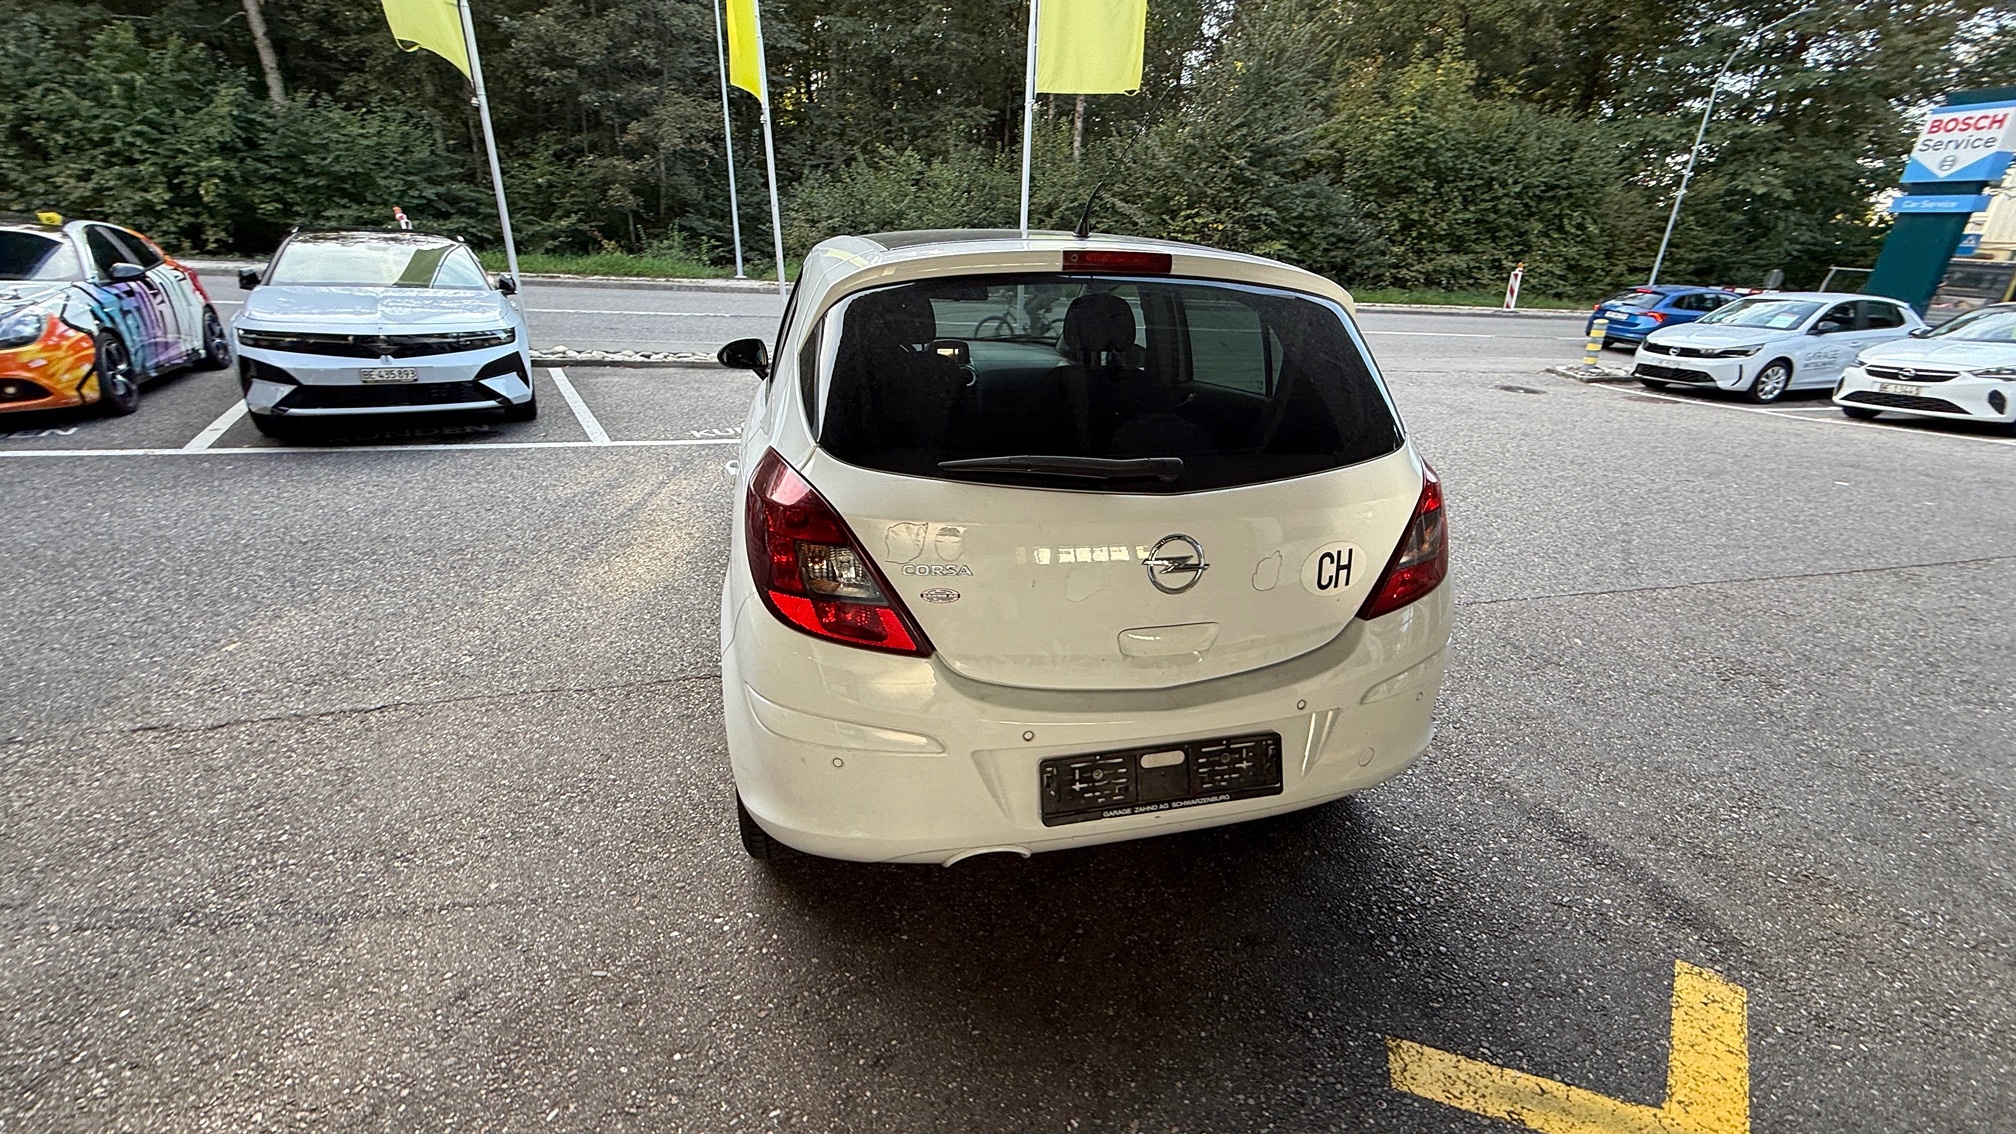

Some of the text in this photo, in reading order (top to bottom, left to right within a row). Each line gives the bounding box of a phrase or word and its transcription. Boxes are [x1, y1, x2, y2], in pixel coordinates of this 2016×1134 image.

[1927, 113, 2009, 134] BOSCH
[1917, 134, 1998, 152] Service
[902, 564, 974, 576] CORSA
[1317, 548, 1353, 590] CH
[1102, 794, 1230, 817] GARAGE ZAHND AG SCHWARZENBURG
